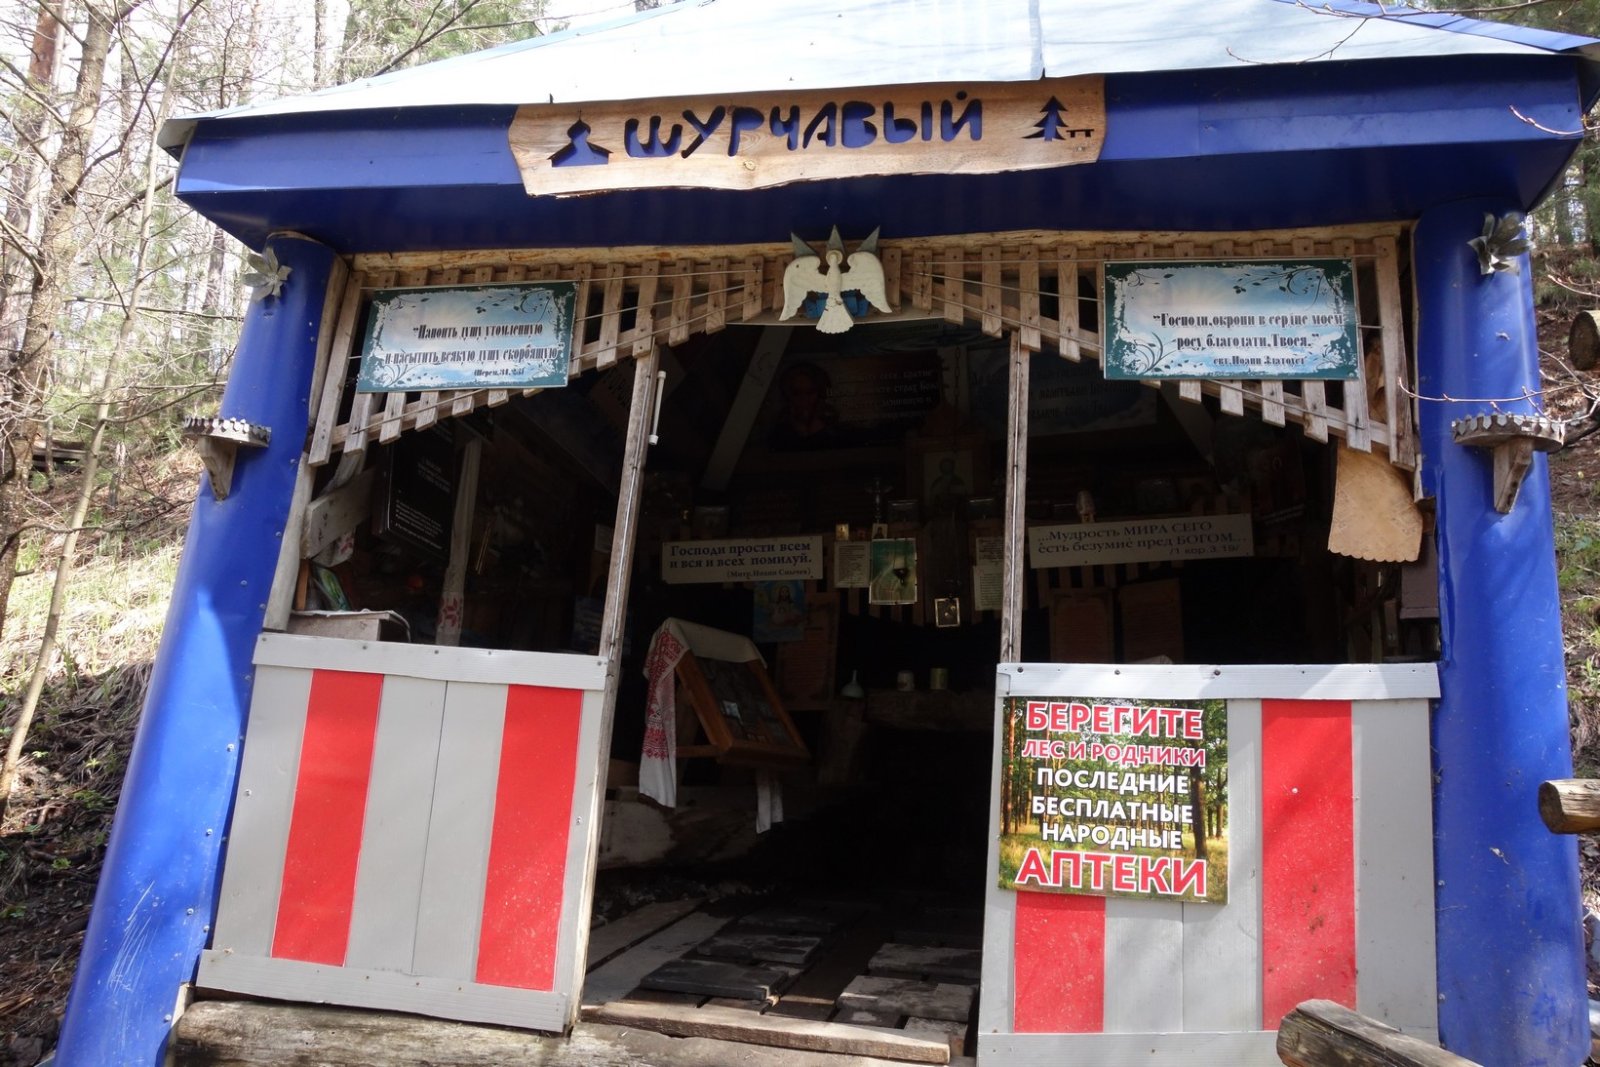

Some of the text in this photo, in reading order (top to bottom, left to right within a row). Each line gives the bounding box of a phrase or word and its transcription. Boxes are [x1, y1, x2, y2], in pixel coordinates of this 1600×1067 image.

[624, 90, 983, 159] ШУРЧАВЫЙ
[1259, 315, 1266, 325] в
[1269, 314, 1308, 328] сердце
[1312, 314, 1343, 325] моем
[1177, 337, 1202, 351] росу
[1124, 523, 1168, 537] МИРА
[1171, 521, 1212, 532] СЕГО
[671, 542, 811, 557] Господи прости всем
[1038, 543, 1069, 554] есть
[1072, 539, 1133, 553] безумие
[1137, 536, 1173, 549] пред
[670, 553, 812, 569] и вся и всех помилуй.
[1026, 700, 1204, 740] БЕРЕГИТЕ
[1022, 739, 1205, 768] ЛЕС И РОДНИКИ
[1037, 768, 1188, 795] ПОСЛЕДНИЕ
[1032, 796, 1193, 824] БЕСПЛАТНЫЕ
[1042, 823, 1182, 850] НАРОДНЫЕ
[1015, 848, 1207, 897] АПТЕКИ
